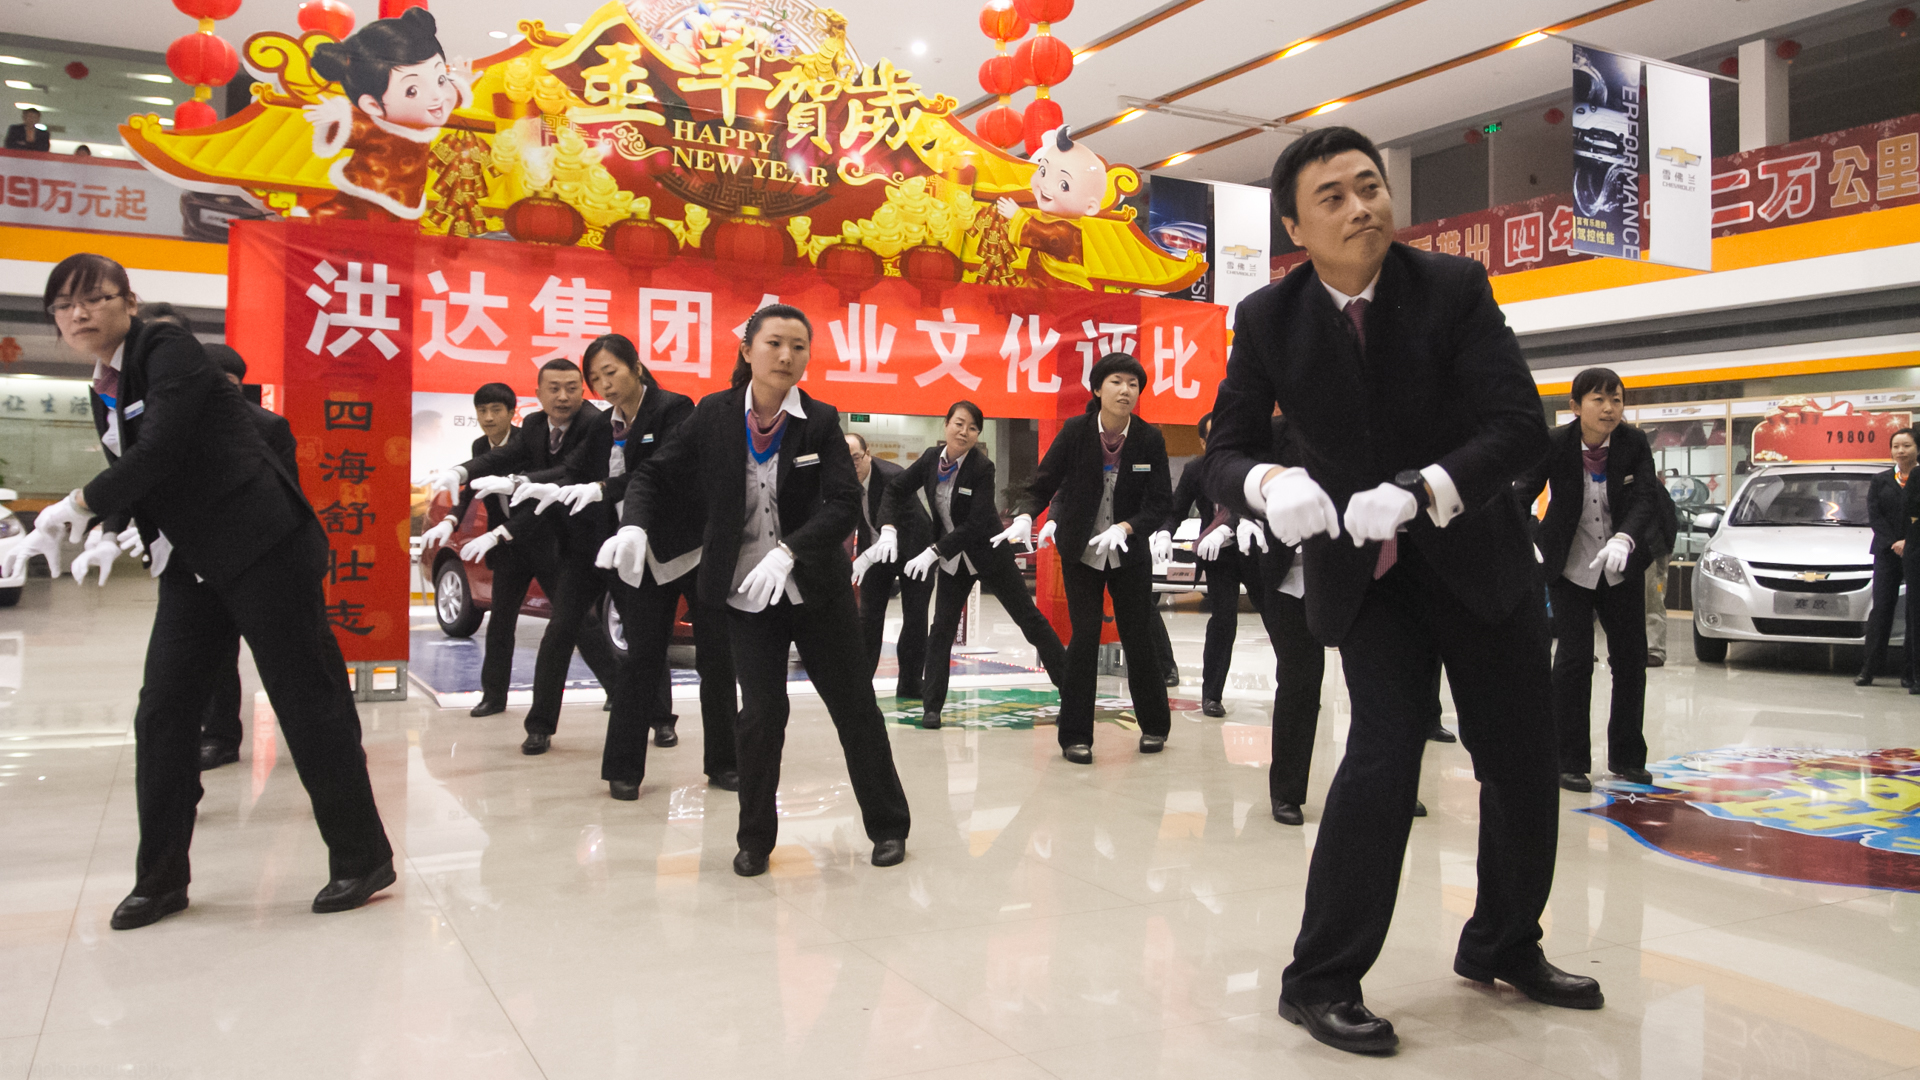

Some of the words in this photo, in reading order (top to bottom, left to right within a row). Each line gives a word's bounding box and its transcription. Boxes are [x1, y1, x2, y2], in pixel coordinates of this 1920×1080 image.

[672, 119, 774, 154] HAPPY
[671, 146, 745, 175] NEW
[750, 157, 829, 187] YEAR
[1622, 70, 1641, 260] PERFORMANCE
[0, 174, 148, 221] 9万元起
[1662, 181, 1696, 192] CHEVROLET
[1577, 227, 1615, 246] 驾控性能
[305, 259, 1201, 399] 洪达集团业文化评比
[1826, 430, 1876, 444] 79800
[318, 399, 376, 636] 四海舒壮志
